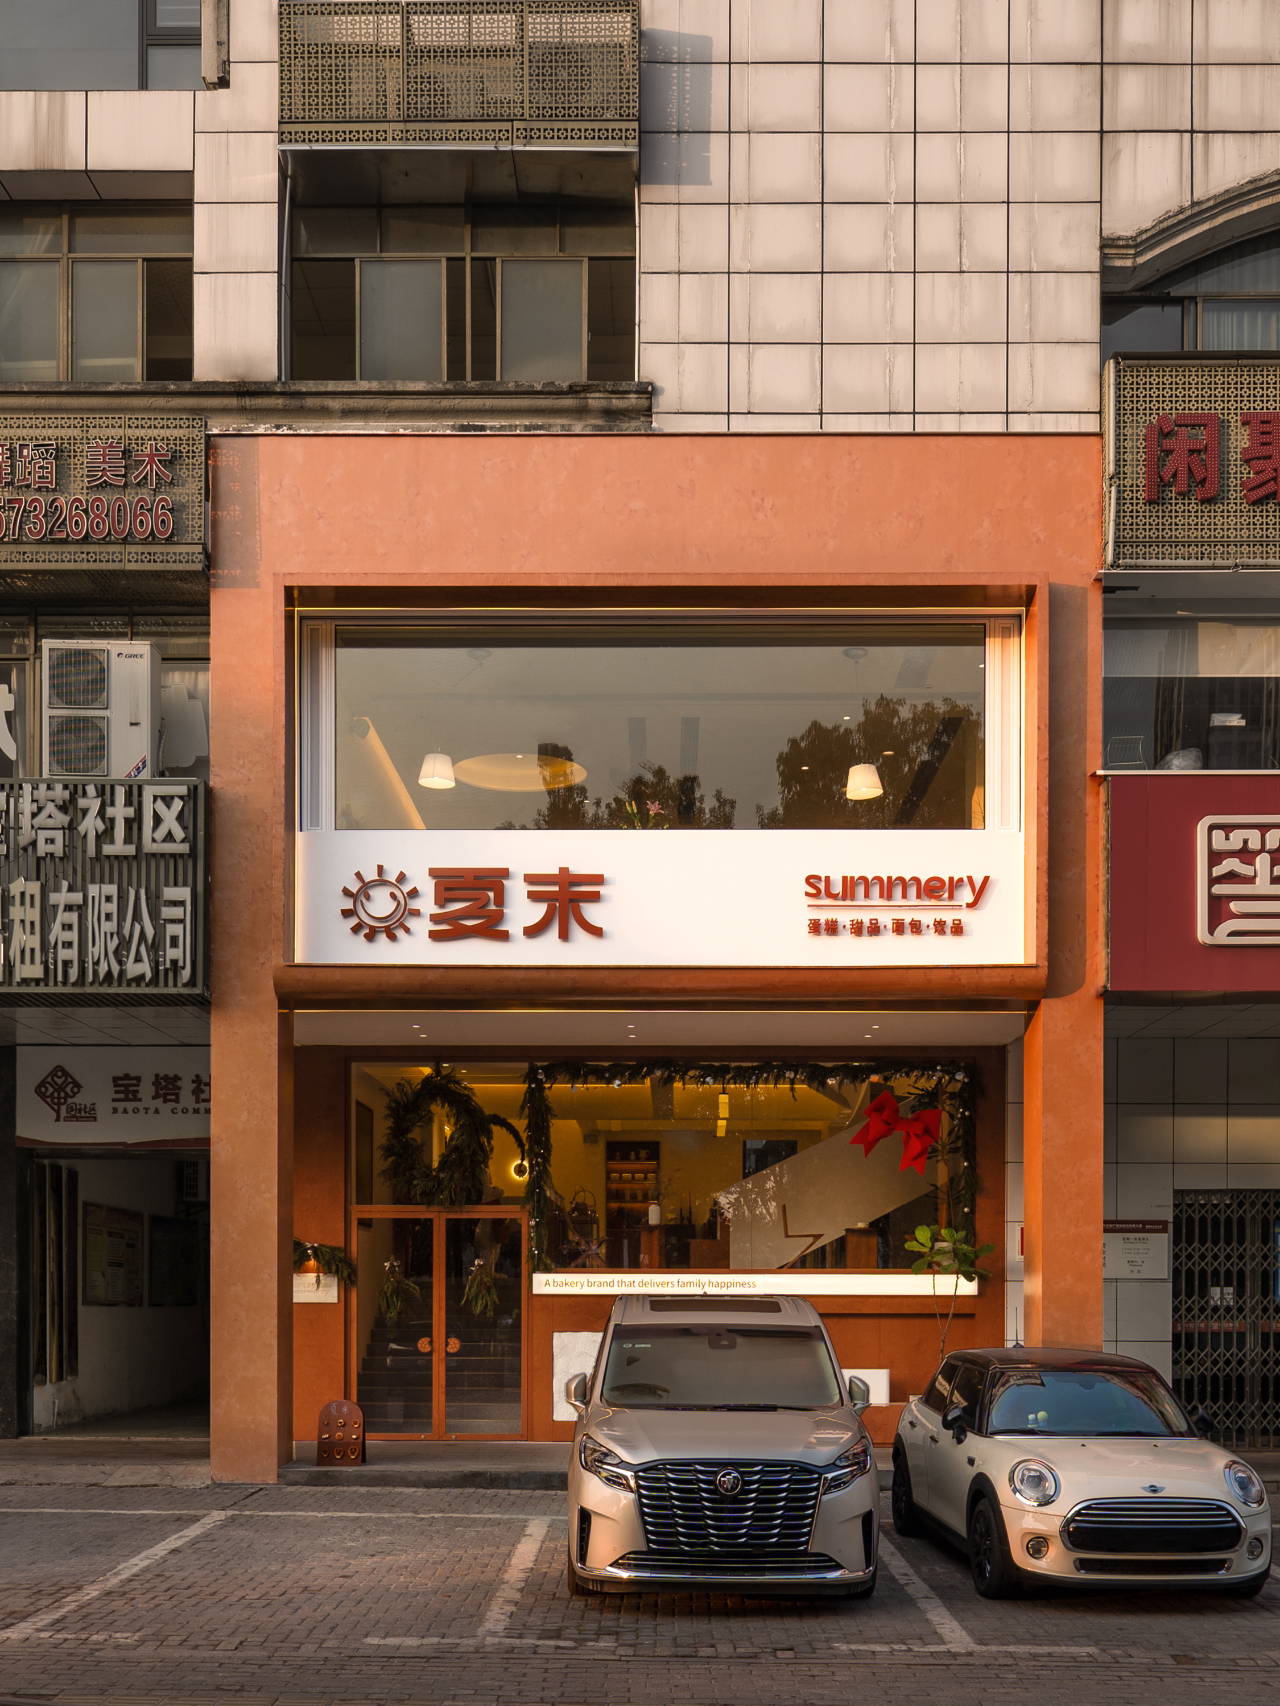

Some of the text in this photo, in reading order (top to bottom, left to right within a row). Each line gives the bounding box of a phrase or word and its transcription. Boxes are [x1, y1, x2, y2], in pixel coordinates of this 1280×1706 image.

[0, 440, 173, 489] 蹈 美术
[0, 496, 173, 539] 73268066
[0, 783, 190, 858] 塔社区
[428, 866, 604, 940] 夏末
[805, 874, 991, 909] summery
[0, 876, 191, 984] 租有限公司
[111, 1107, 160, 1115] BAOTA
[544, 1278, 757, 1290] A bakery brand that delivers family happiness
